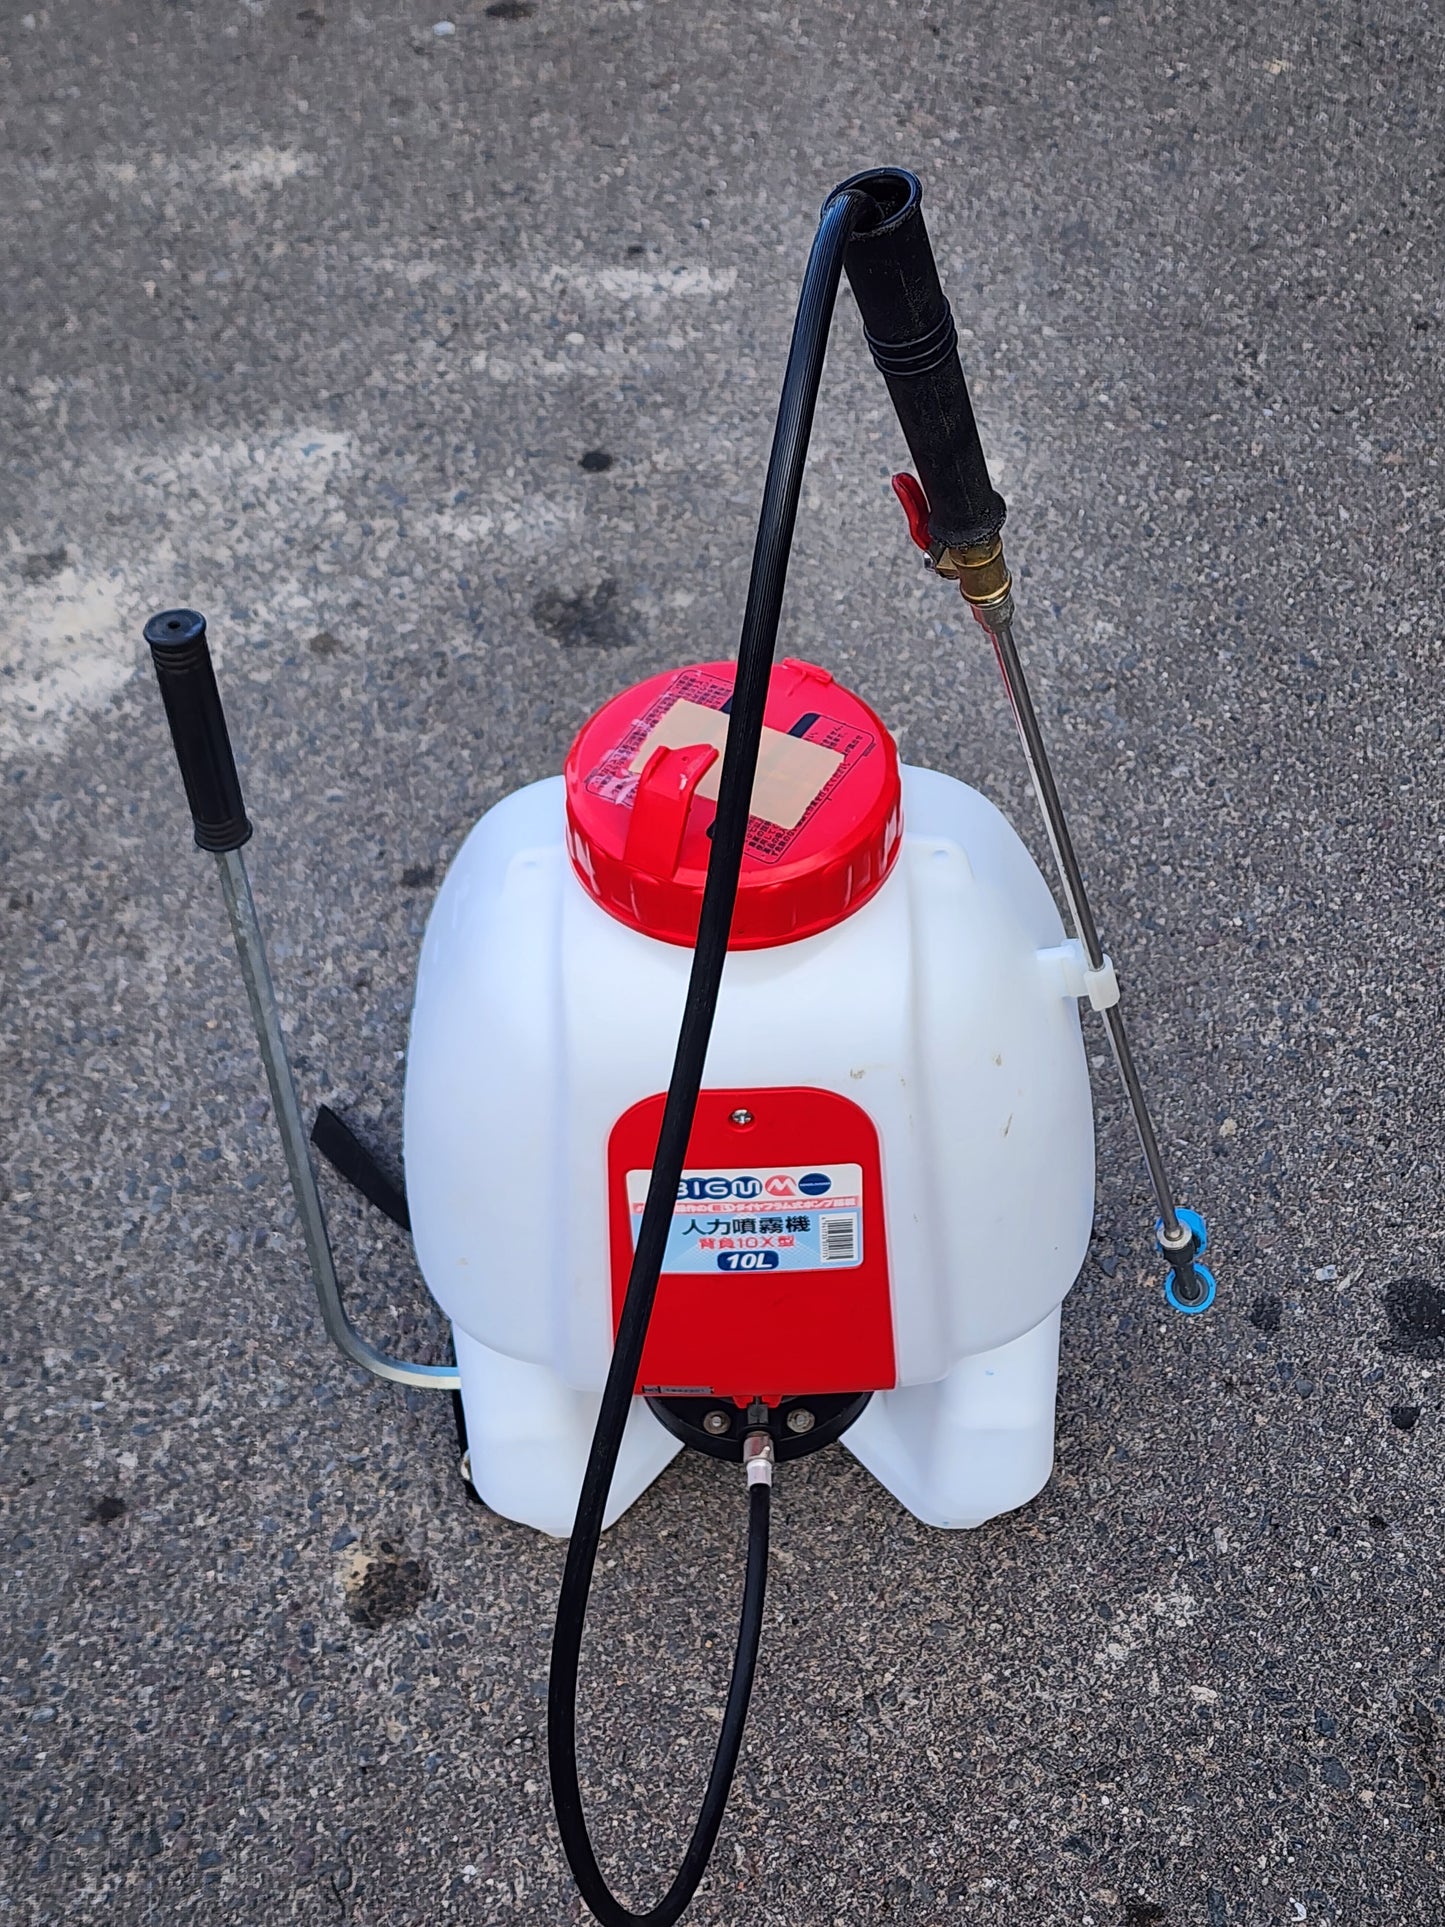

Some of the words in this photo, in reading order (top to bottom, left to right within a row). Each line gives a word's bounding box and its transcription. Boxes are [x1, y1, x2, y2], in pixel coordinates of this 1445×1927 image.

[682, 1215, 811, 1235] 人力噴霧機
[727, 1253, 773, 1269] 10L
